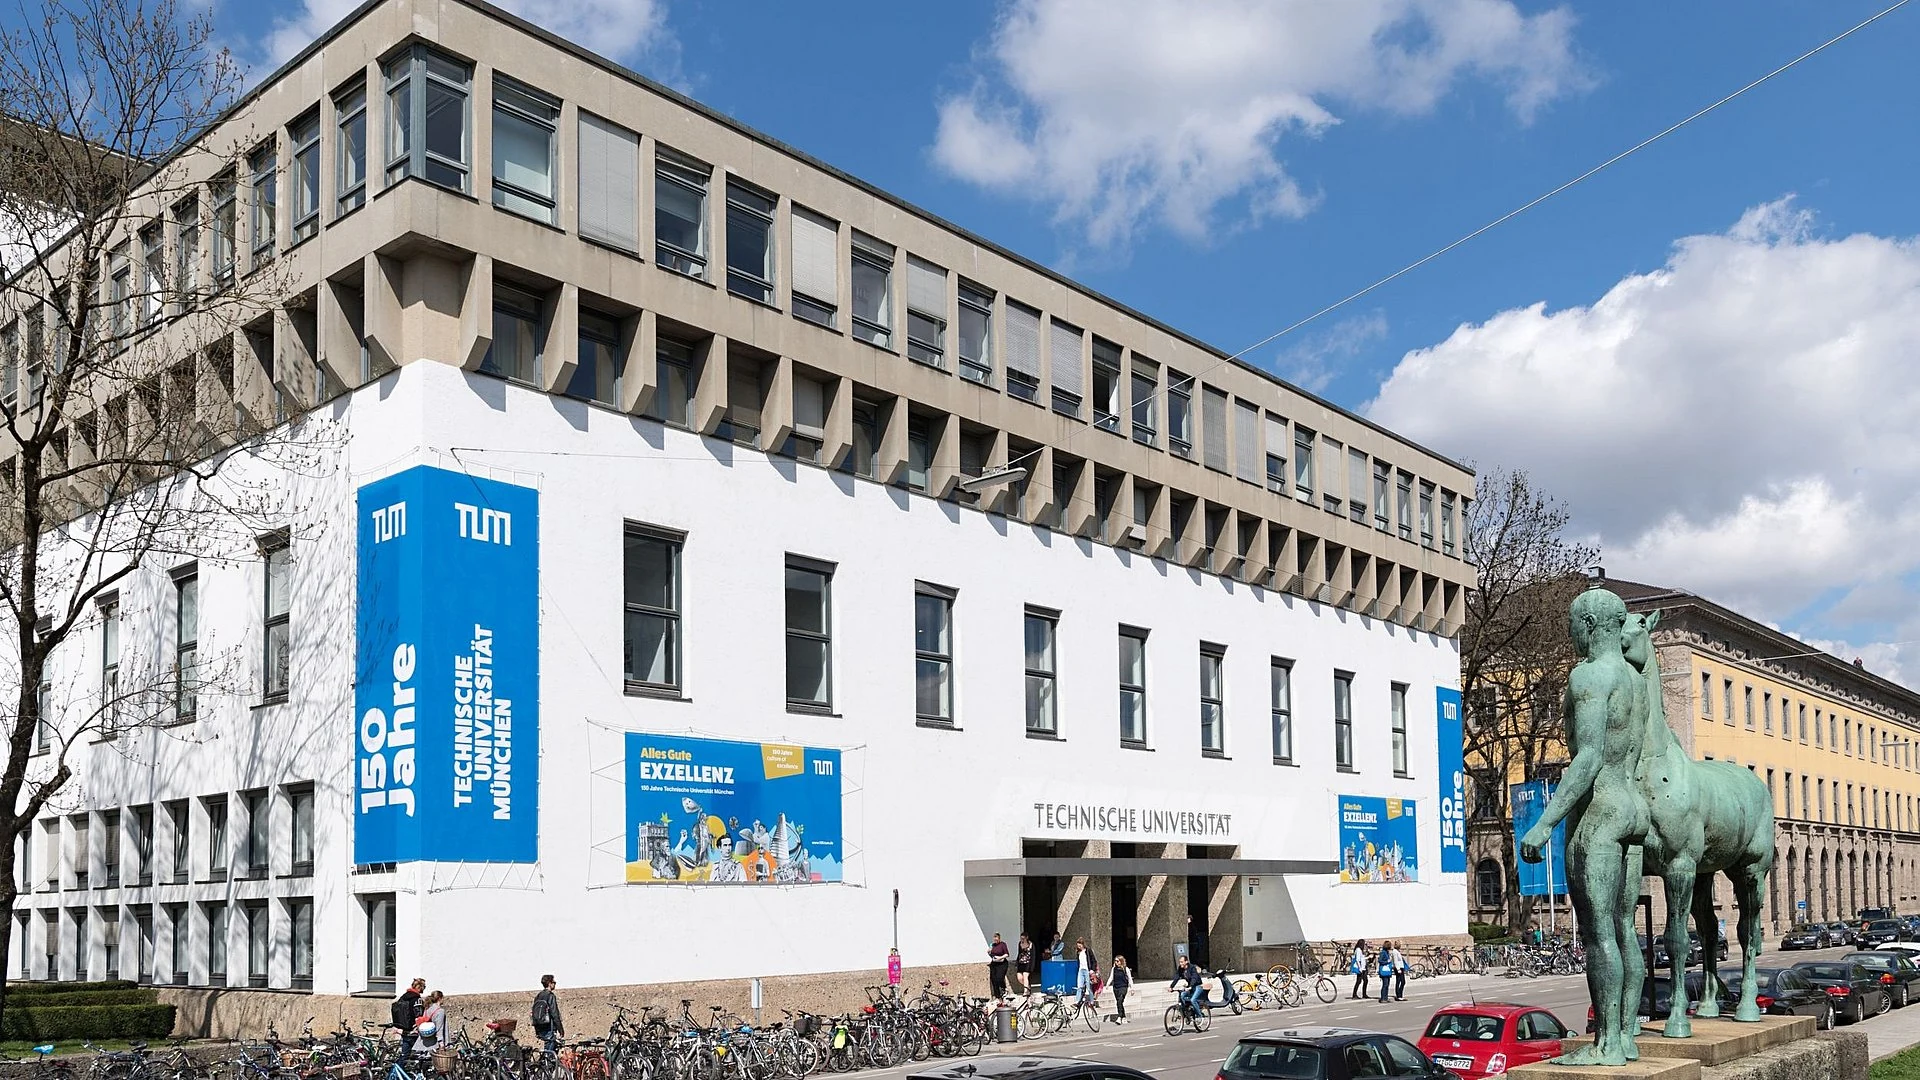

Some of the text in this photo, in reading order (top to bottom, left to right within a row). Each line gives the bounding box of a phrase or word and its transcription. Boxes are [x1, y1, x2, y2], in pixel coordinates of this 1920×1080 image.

[372, 501, 406, 544] TUM
[455, 502, 511, 546] TUM
[471, 623, 493, 781] UNIVERSITÄT
[1442, 701, 1457, 721] TUM
[387, 643, 416, 817] Jahre
[453, 655, 473, 808] TECHNISCHE
[360, 707, 387, 814] 150
[490, 698, 512, 820] MÜNCHEN
[640, 747, 692, 761] Alles Gute
[640, 761, 735, 784] EXZELLENZ
[812, 759, 833, 776] TUM
[664, 785, 690, 793] Technische
[1033, 803, 1232, 836] TECHNISCHE UNIVERSITÄT
[1441, 796, 1454, 848] 150
[1452, 770, 1465, 853] Jahre
